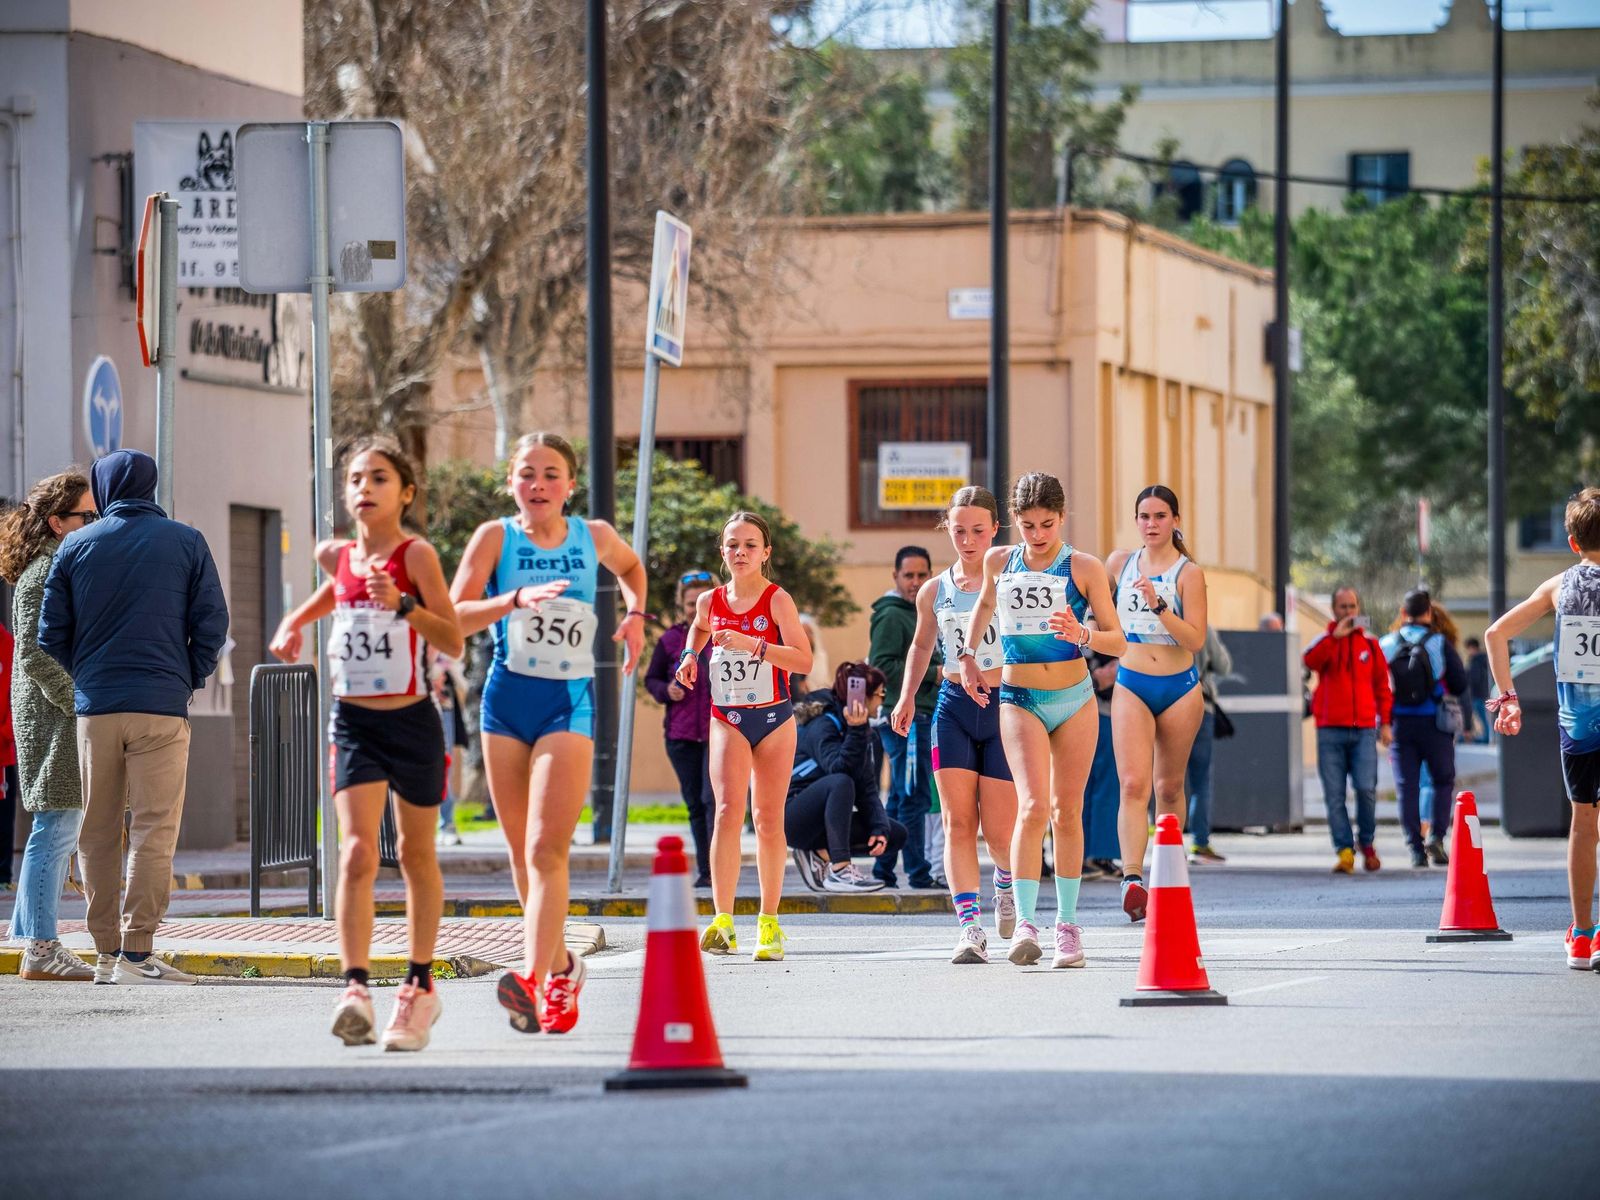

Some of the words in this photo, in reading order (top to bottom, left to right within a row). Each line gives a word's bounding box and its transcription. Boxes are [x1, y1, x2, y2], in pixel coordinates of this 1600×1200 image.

[518, 554, 586, 573] nerja
[1010, 586, 1053, 610] 353
[526, 615, 583, 649] 356
[954, 627, 997, 646] 30
[340, 631, 393, 662] 334
[720, 660, 761, 682] 337
